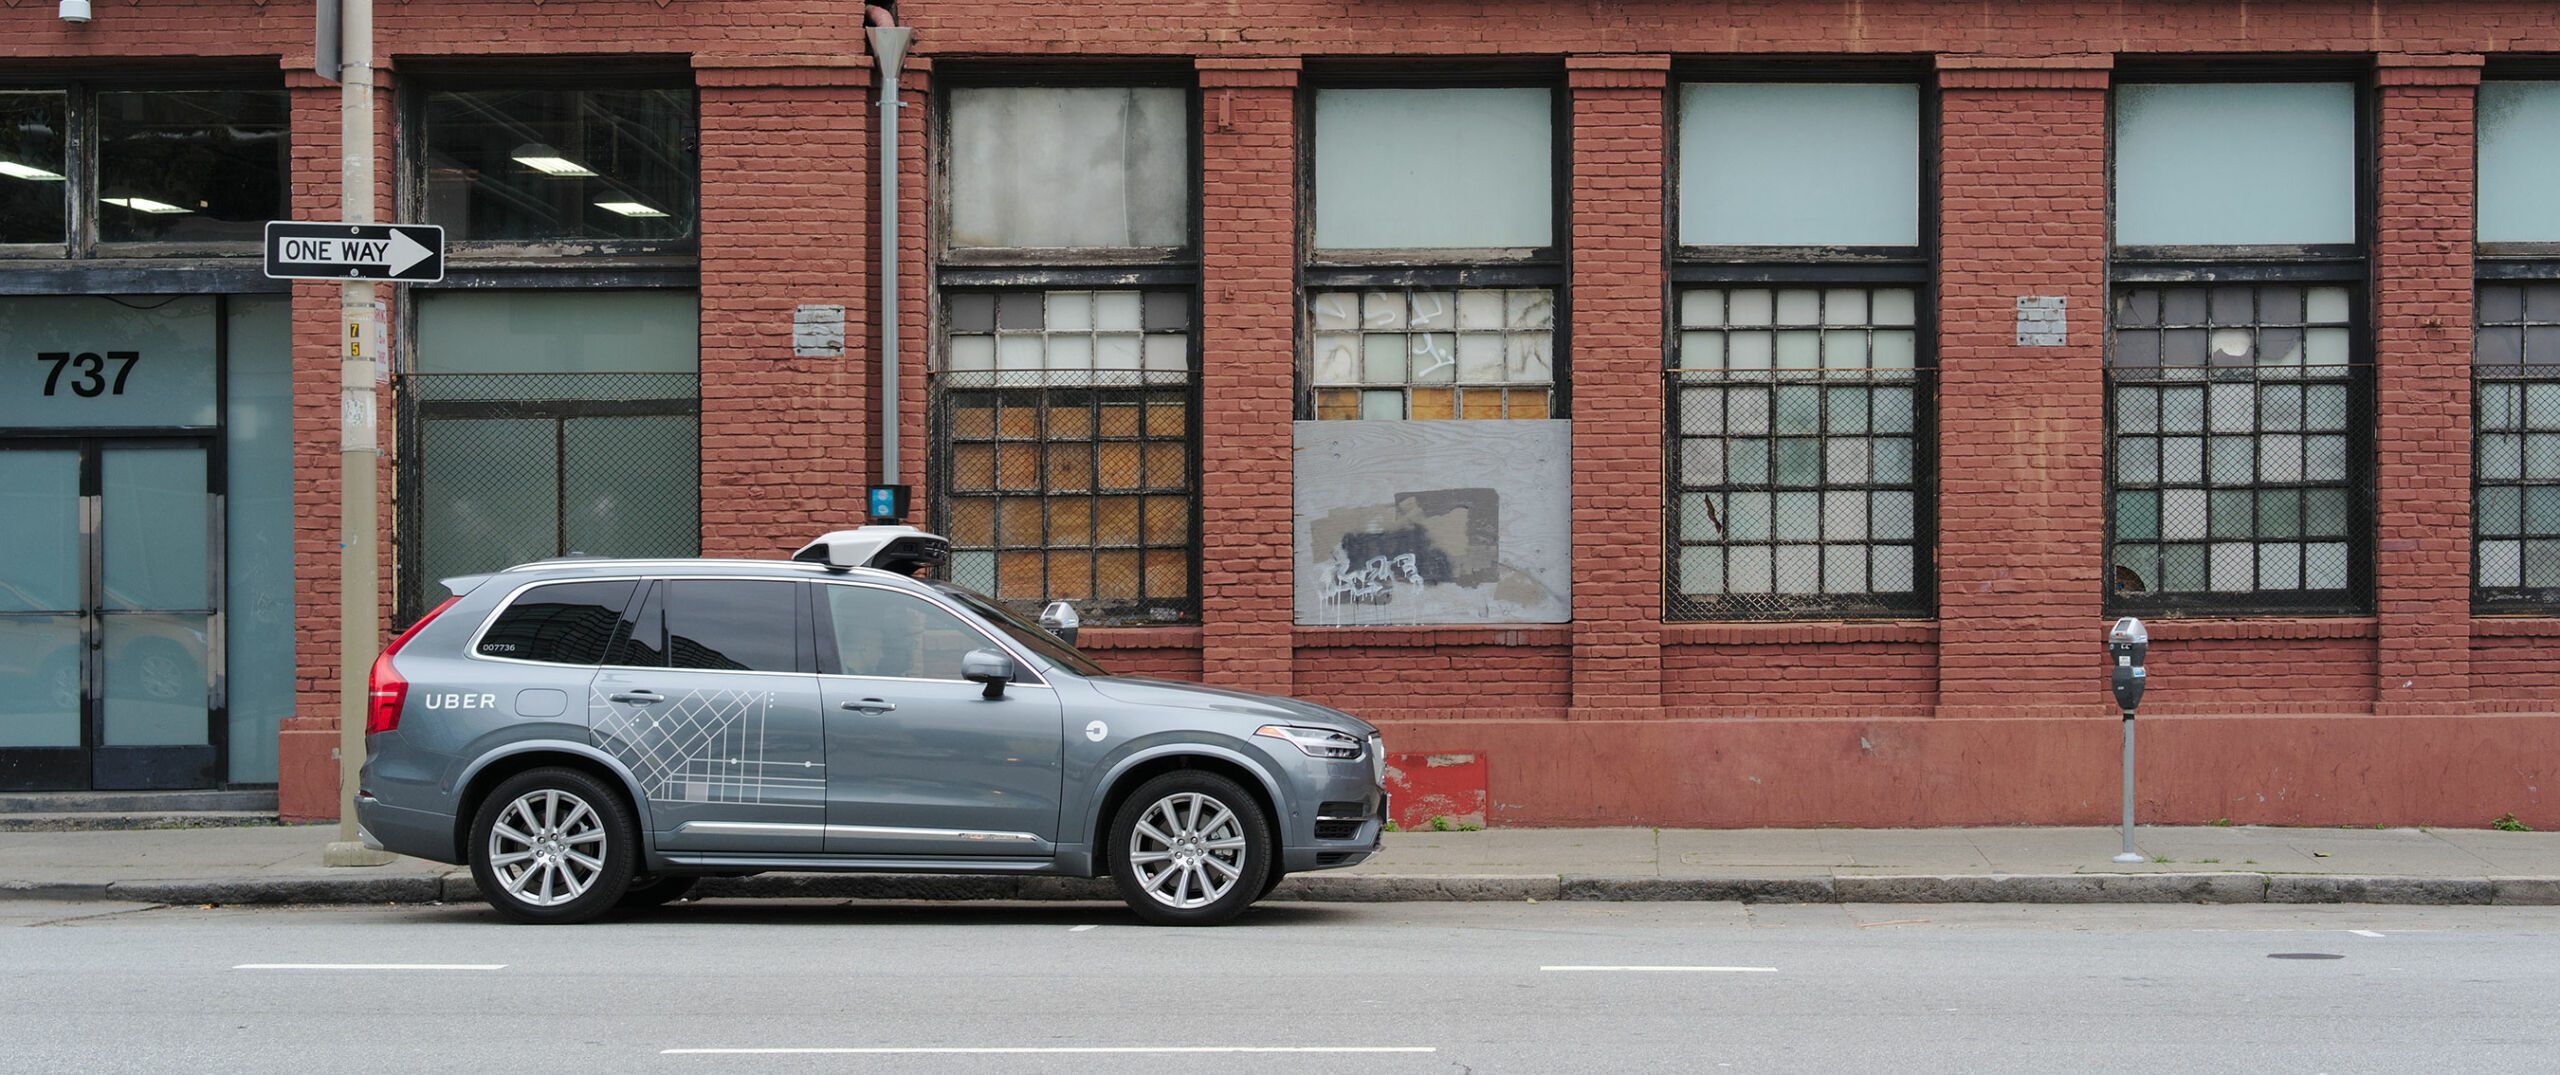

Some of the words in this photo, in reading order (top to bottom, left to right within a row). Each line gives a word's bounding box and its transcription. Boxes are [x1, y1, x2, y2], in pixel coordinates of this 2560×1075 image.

[285, 240, 332, 261] ONE
[342, 241, 389, 261] WAY
[351, 324, 359, 337] 7
[352, 343, 359, 356] 5
[37, 351, 140, 398] 737
[426, 694, 496, 709] UBER
